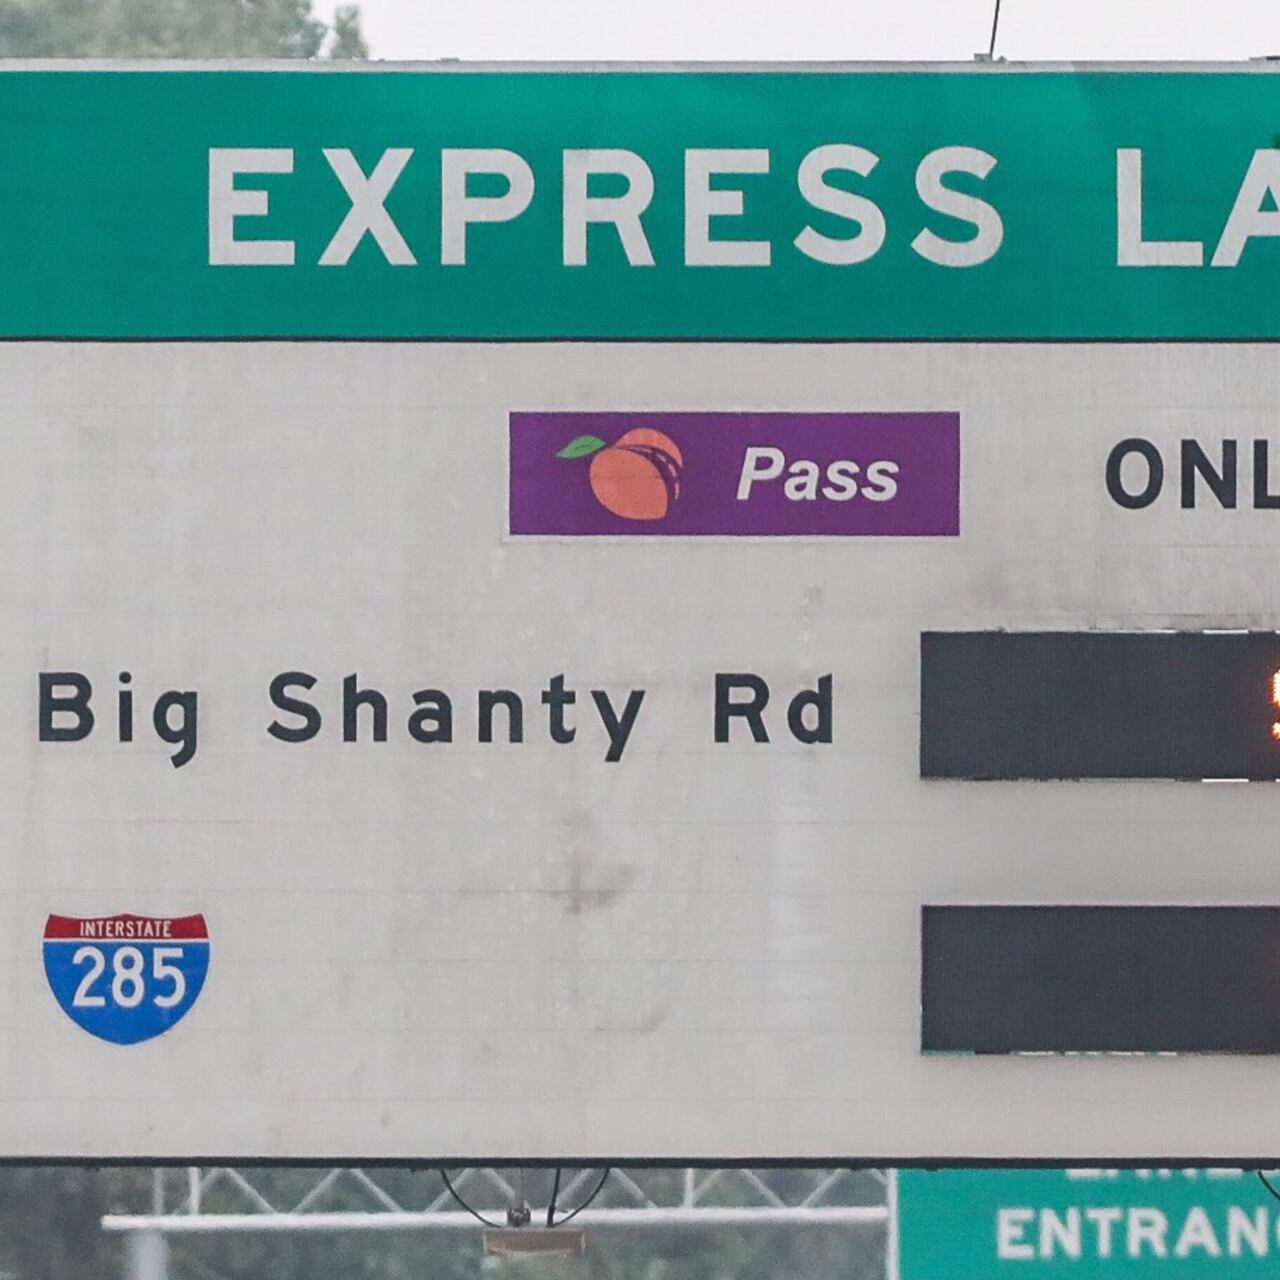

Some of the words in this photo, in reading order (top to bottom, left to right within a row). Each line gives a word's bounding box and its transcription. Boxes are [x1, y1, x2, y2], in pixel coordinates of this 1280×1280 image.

[207, 143, 1005, 269] EXPRESS
[736, 446, 900, 502] Pass
[38, 671, 198, 769] Big
[267, 671, 646, 763] Shanty
[714, 672, 833, 745] Rd
[80, 921, 172, 937] INTERSTATE
[72, 946, 186, 1008] 285
